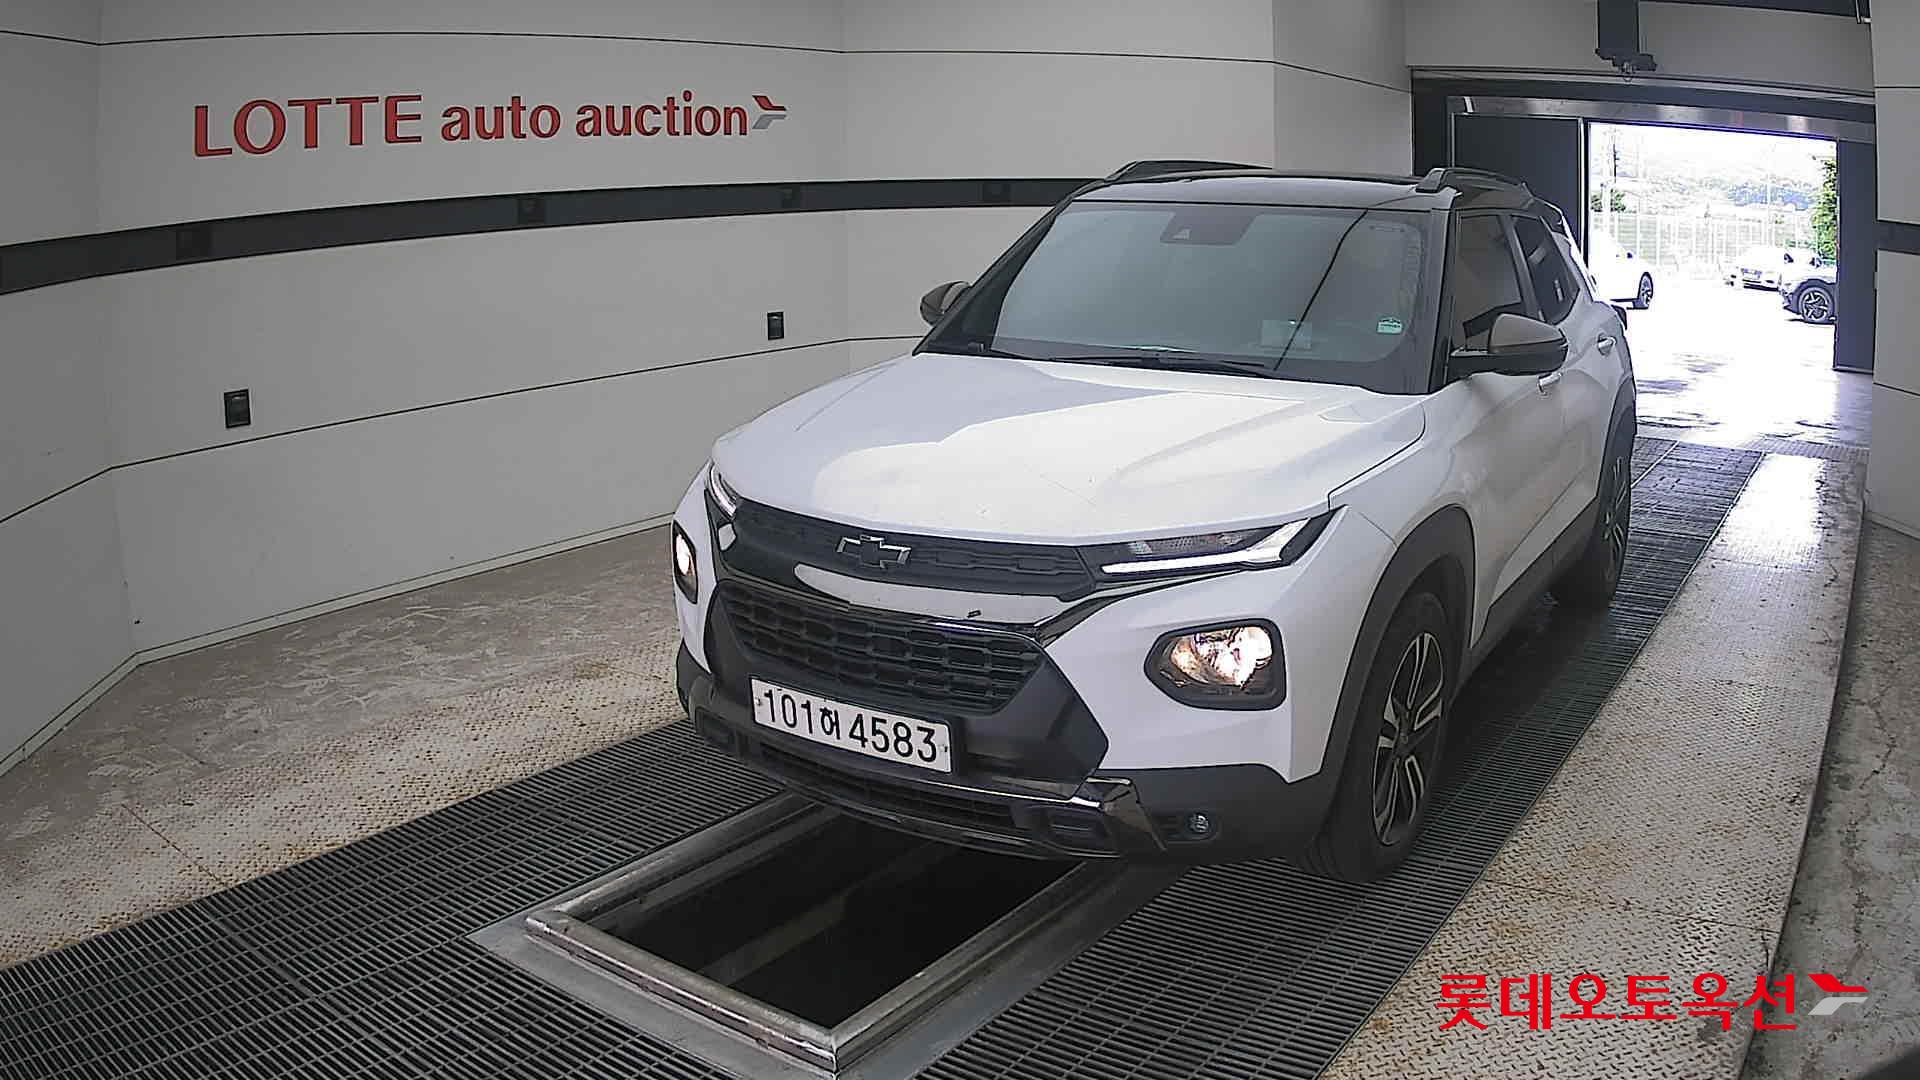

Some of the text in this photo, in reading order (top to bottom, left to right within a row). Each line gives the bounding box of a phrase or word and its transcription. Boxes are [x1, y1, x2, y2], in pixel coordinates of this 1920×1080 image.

[194, 90, 748, 157] LOTTE auto auction
[764, 689, 938, 763] 101허 4583
